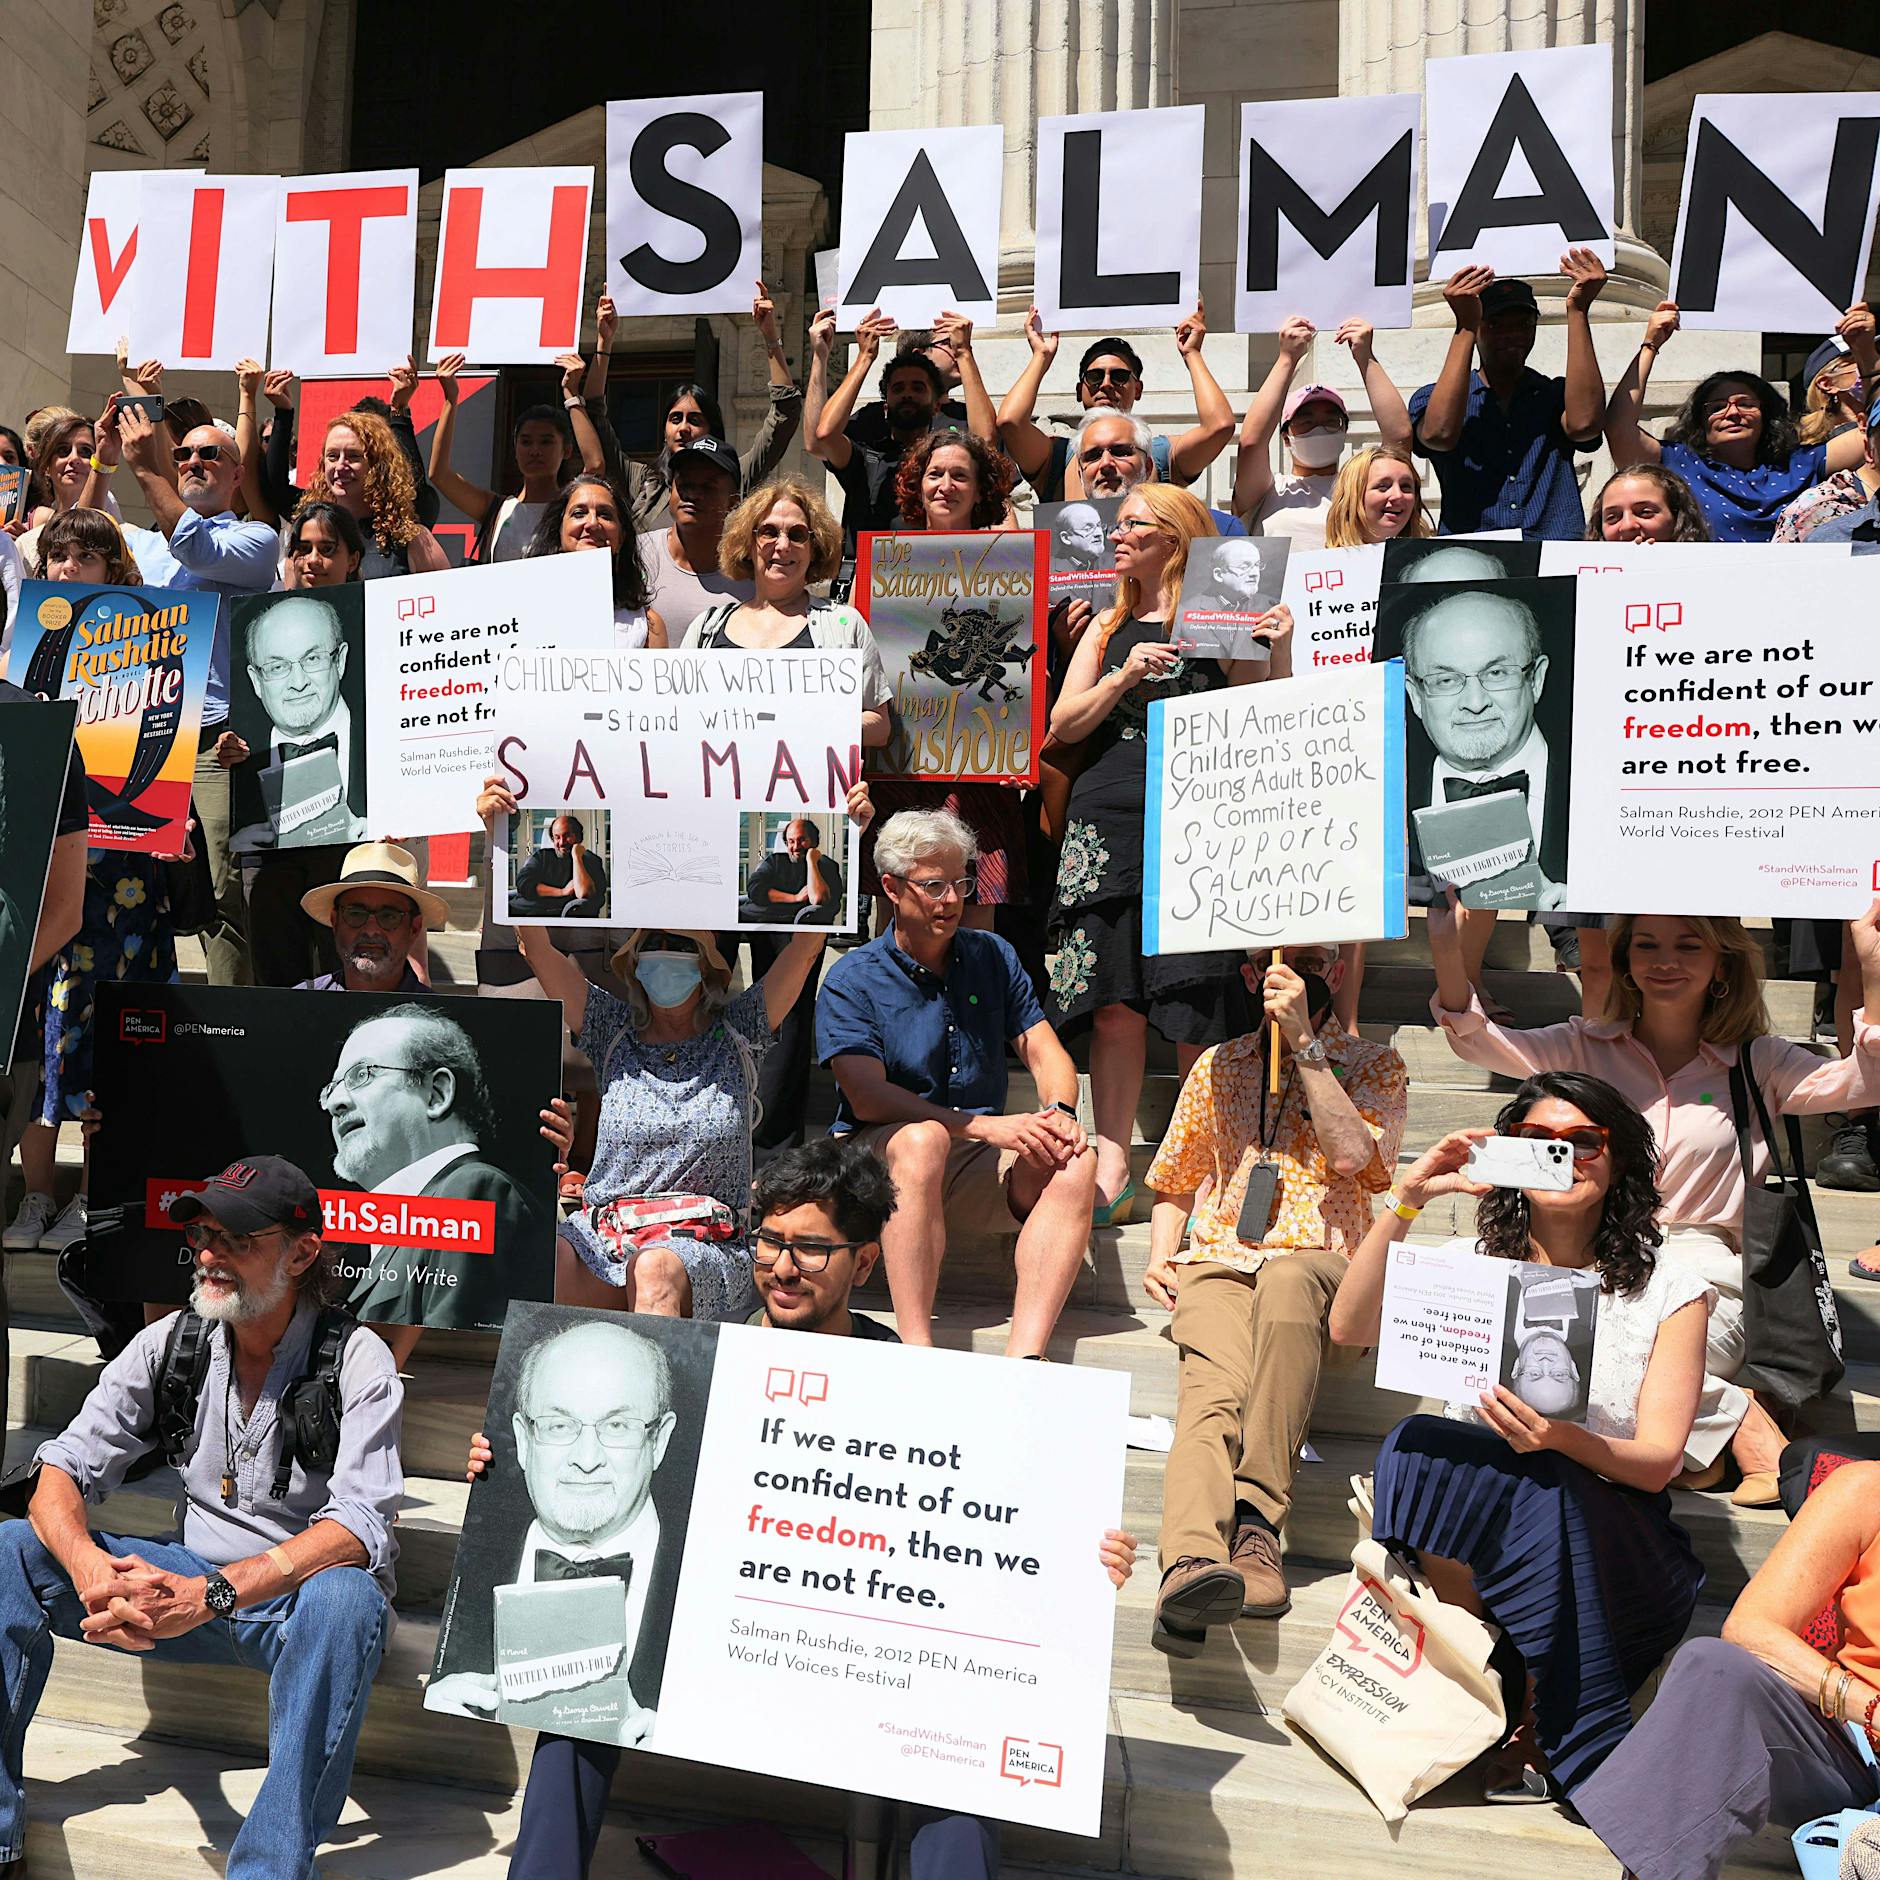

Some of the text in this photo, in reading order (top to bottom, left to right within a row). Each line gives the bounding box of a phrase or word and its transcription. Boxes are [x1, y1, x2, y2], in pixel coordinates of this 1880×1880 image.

[875, 531, 912, 570] The
[872, 531, 1032, 605] Satanic Verses
[1048, 572, 1116, 582] StandWithSalman
[1309, 600, 1380, 616] If we ar
[76, 604, 189, 650] Salman
[400, 618, 519, 646] If we are not
[1311, 624, 1377, 642] confid
[67, 630, 188, 688] Rushdie
[400, 649, 491, 674] confident
[1626, 640, 1814, 667] If we are not
[504, 654, 857, 696] CHILDREN'S BOOK WRITERS
[1624, 674, 1874, 703] confident of our
[400, 679, 489, 701] freedom,
[148, 712, 174, 722] NEW YORK
[152, 721, 167, 729] TIMES
[400, 706, 468, 728] are not
[1174, 698, 1366, 748] PEN America's
[1624, 712, 1842, 740] freedom, then
[143, 728, 174, 739] BESTSELLER
[400, 746, 482, 762] Salman Rushdie,
[1171, 728, 1355, 781] Children's and
[1622, 750, 1810, 774] are not free.
[400, 760, 494, 776] World Voices Festi
[497, 736, 861, 808] SALMAN
[1170, 755, 1377, 810] Young Adult Book
[1214, 797, 1322, 828] Commitee
[1620, 806, 1880, 820] Salman Rushdie, 2012 PEN Ameri
[1175, 818, 1358, 869] Supports
[1620, 826, 1784, 838] World Voices Festival
[1758, 864, 1858, 875] #StandWithSalman
[1780, 878, 1858, 888] @PENamerica
[1172, 860, 1334, 920] SALMAN
[1208, 886, 1356, 938] RUSHDIE
[125, 1026, 160, 1034] AMERICA
[174, 1023, 245, 1036] @PENamerica
[380, 1264, 398, 1282] to
[406, 1264, 458, 1287] Write
[1393, 1316, 1491, 1344] freedom, then we
[1423, 1308, 1492, 1326] are not free.
[1400, 1334, 1490, 1354] confident of our
[1418, 1350, 1488, 1372] If we are not
[760, 1417, 961, 1470] If we are not
[754, 1468, 1019, 1524] confident of our
[748, 1504, 1040, 1576] freedom, then we
[739, 1560, 946, 1610] are not free.
[1362, 1596, 1392, 1624] PEN
[1350, 1610, 1410, 1661] AMERICA
[507, 1648, 528, 1656] Novel
[730, 1618, 1038, 1686] Salman Rushdie, 2012 PEN America
[504, 1668, 548, 1687] NINETEEN
[728, 1643, 911, 1690] World Voices Festival
[1326, 1654, 1410, 1713] EXPRESSION
[552, 1706, 562, 1718] by
[564, 1706, 588, 1716] George
[1336, 1686, 1390, 1725] INSTITUTE
[878, 1722, 987, 1751] #StandWithSalman
[900, 1744, 986, 1768] @PENamerica
[1010, 1748, 1030, 1758] PEN
[1008, 1760, 1055, 1774] AMERICA
